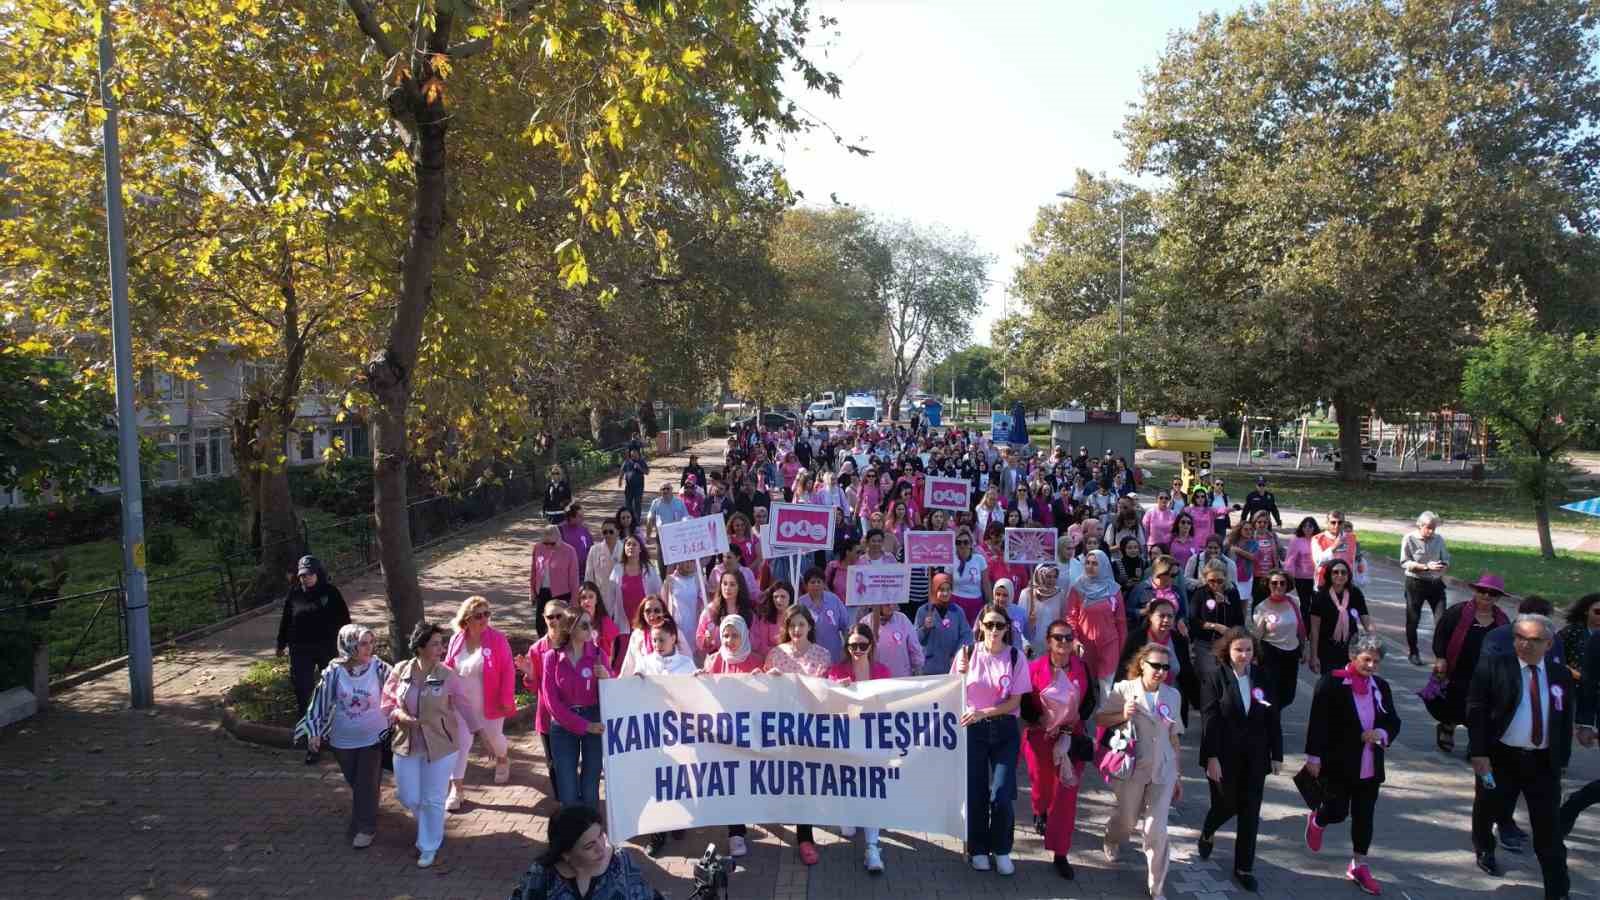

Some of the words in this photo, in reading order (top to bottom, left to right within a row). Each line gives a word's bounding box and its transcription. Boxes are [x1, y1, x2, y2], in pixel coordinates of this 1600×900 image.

[607, 710, 751, 756] KANSERDE
[761, 711, 851, 749] ERKEN
[860, 702, 958, 757] TEŞHİS
[655, 761, 740, 801] HAYAT
[750, 760, 900, 799] KURTARIR"
